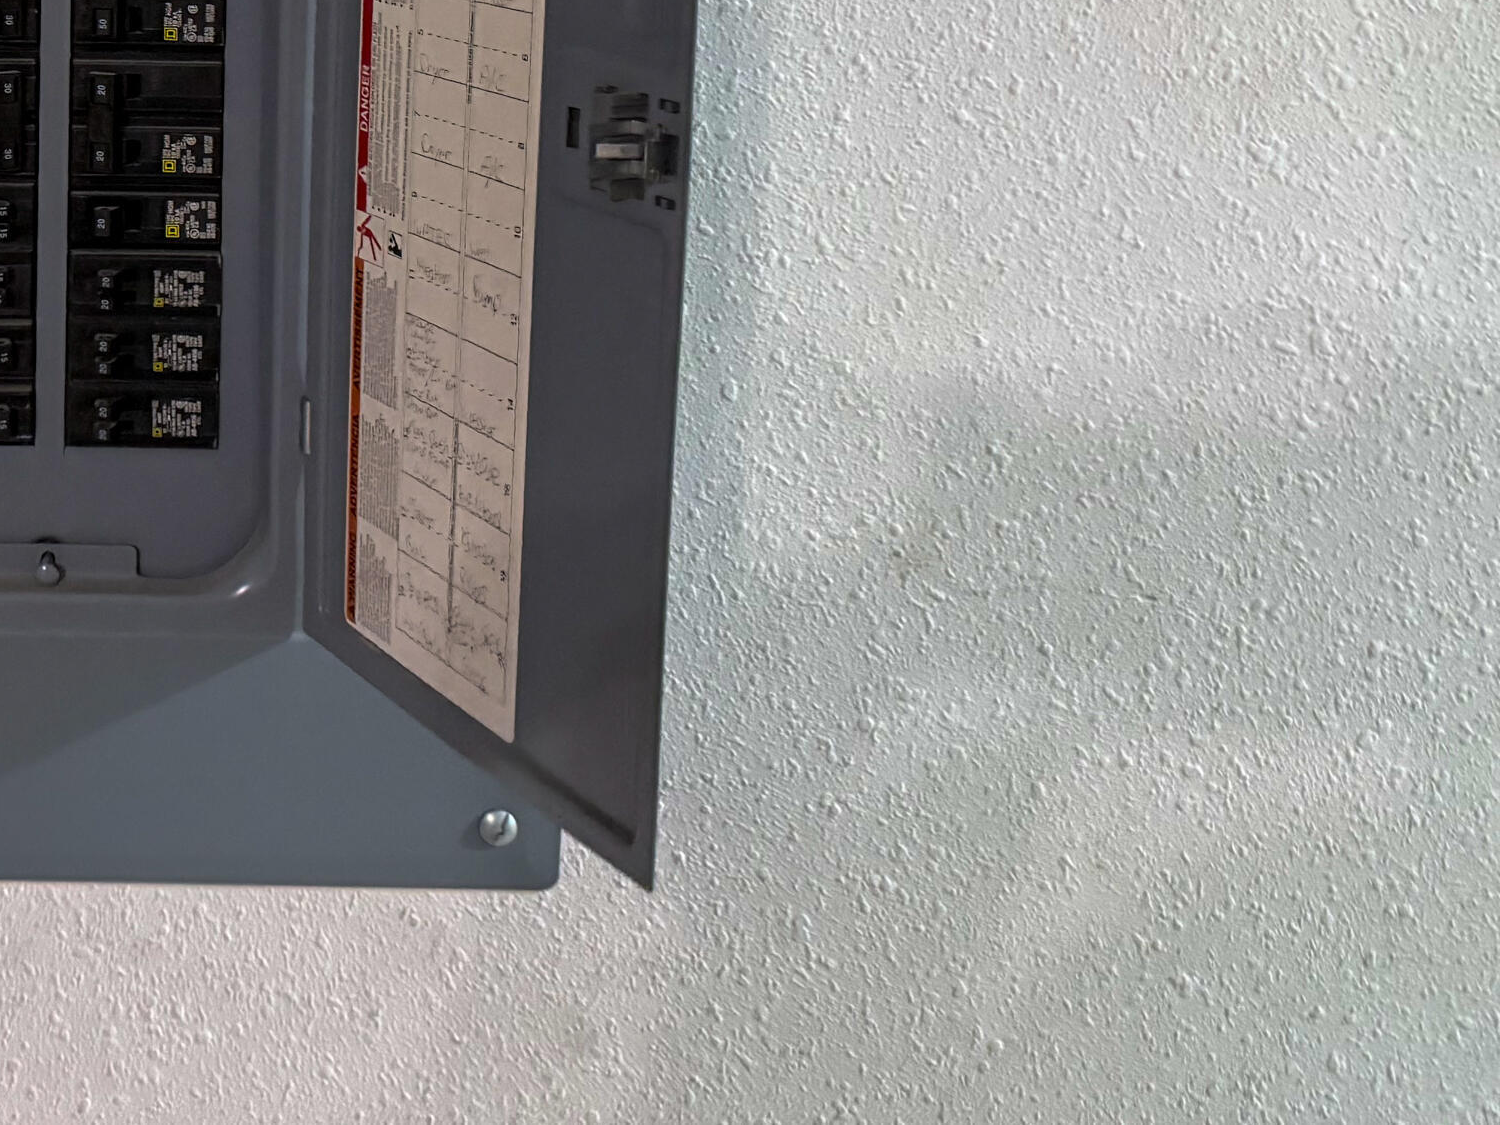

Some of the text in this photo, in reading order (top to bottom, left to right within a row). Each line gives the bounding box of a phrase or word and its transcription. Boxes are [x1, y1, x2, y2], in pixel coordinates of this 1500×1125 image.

[3, 82, 12, 94] 30
[97, 84, 106, 96] 20
[360, 64, 371, 133] DANGER
[4, 148, 13, 160] 30
[96, 150, 105, 162] 20
[0, 206, 8, 217] 15
[97, 218, 106, 230] 20
[0, 228, 8, 239] 15
[101, 276, 110, 288] 20
[100, 299, 109, 310] 20
[99, 341, 108, 352] 20
[0, 352, 9, 363] 15
[98, 407, 108, 418] 20
